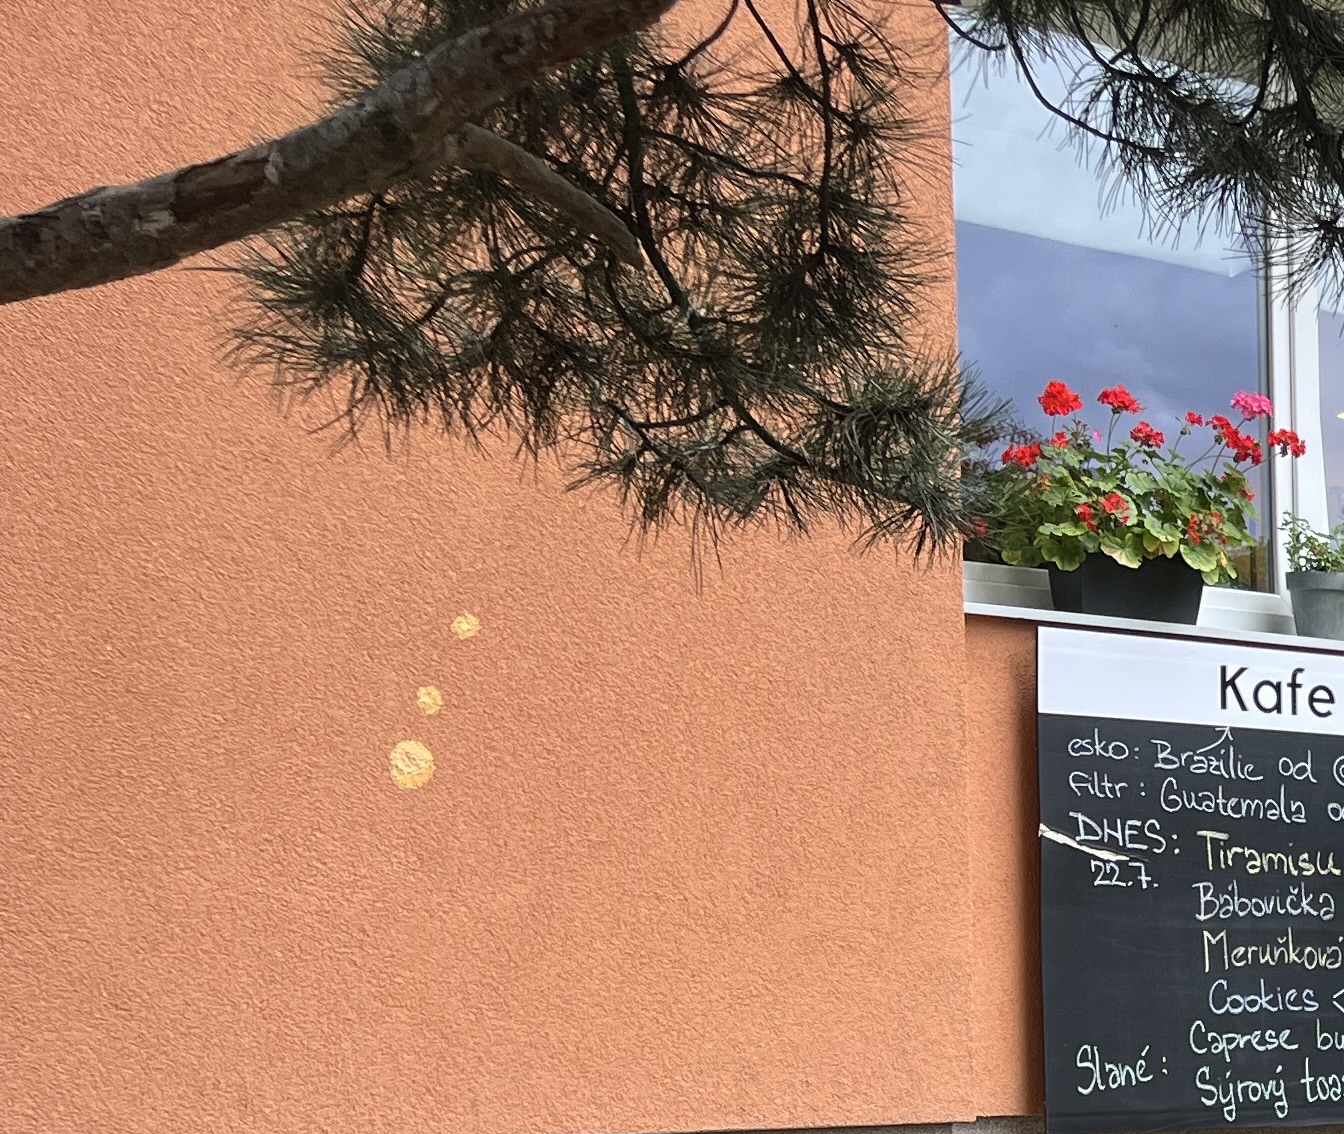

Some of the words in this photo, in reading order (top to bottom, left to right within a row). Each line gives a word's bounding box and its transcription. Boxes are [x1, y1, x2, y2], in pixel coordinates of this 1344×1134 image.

[1219, 664, 1336, 718] Kafe
[1278, 749, 1318, 783] od
[1159, 777, 1307, 824] Guatemala
[1089, 859, 1159, 890] 22.7.
[1191, 879, 1336, 922] Bábovička
[1202, 926, 1344, 974] Meruňková
[1208, 978, 1320, 1015] Cookies
[1189, 1019, 1299, 1063] Caprese
[1195, 1064, 1289, 1122] Sýrový
